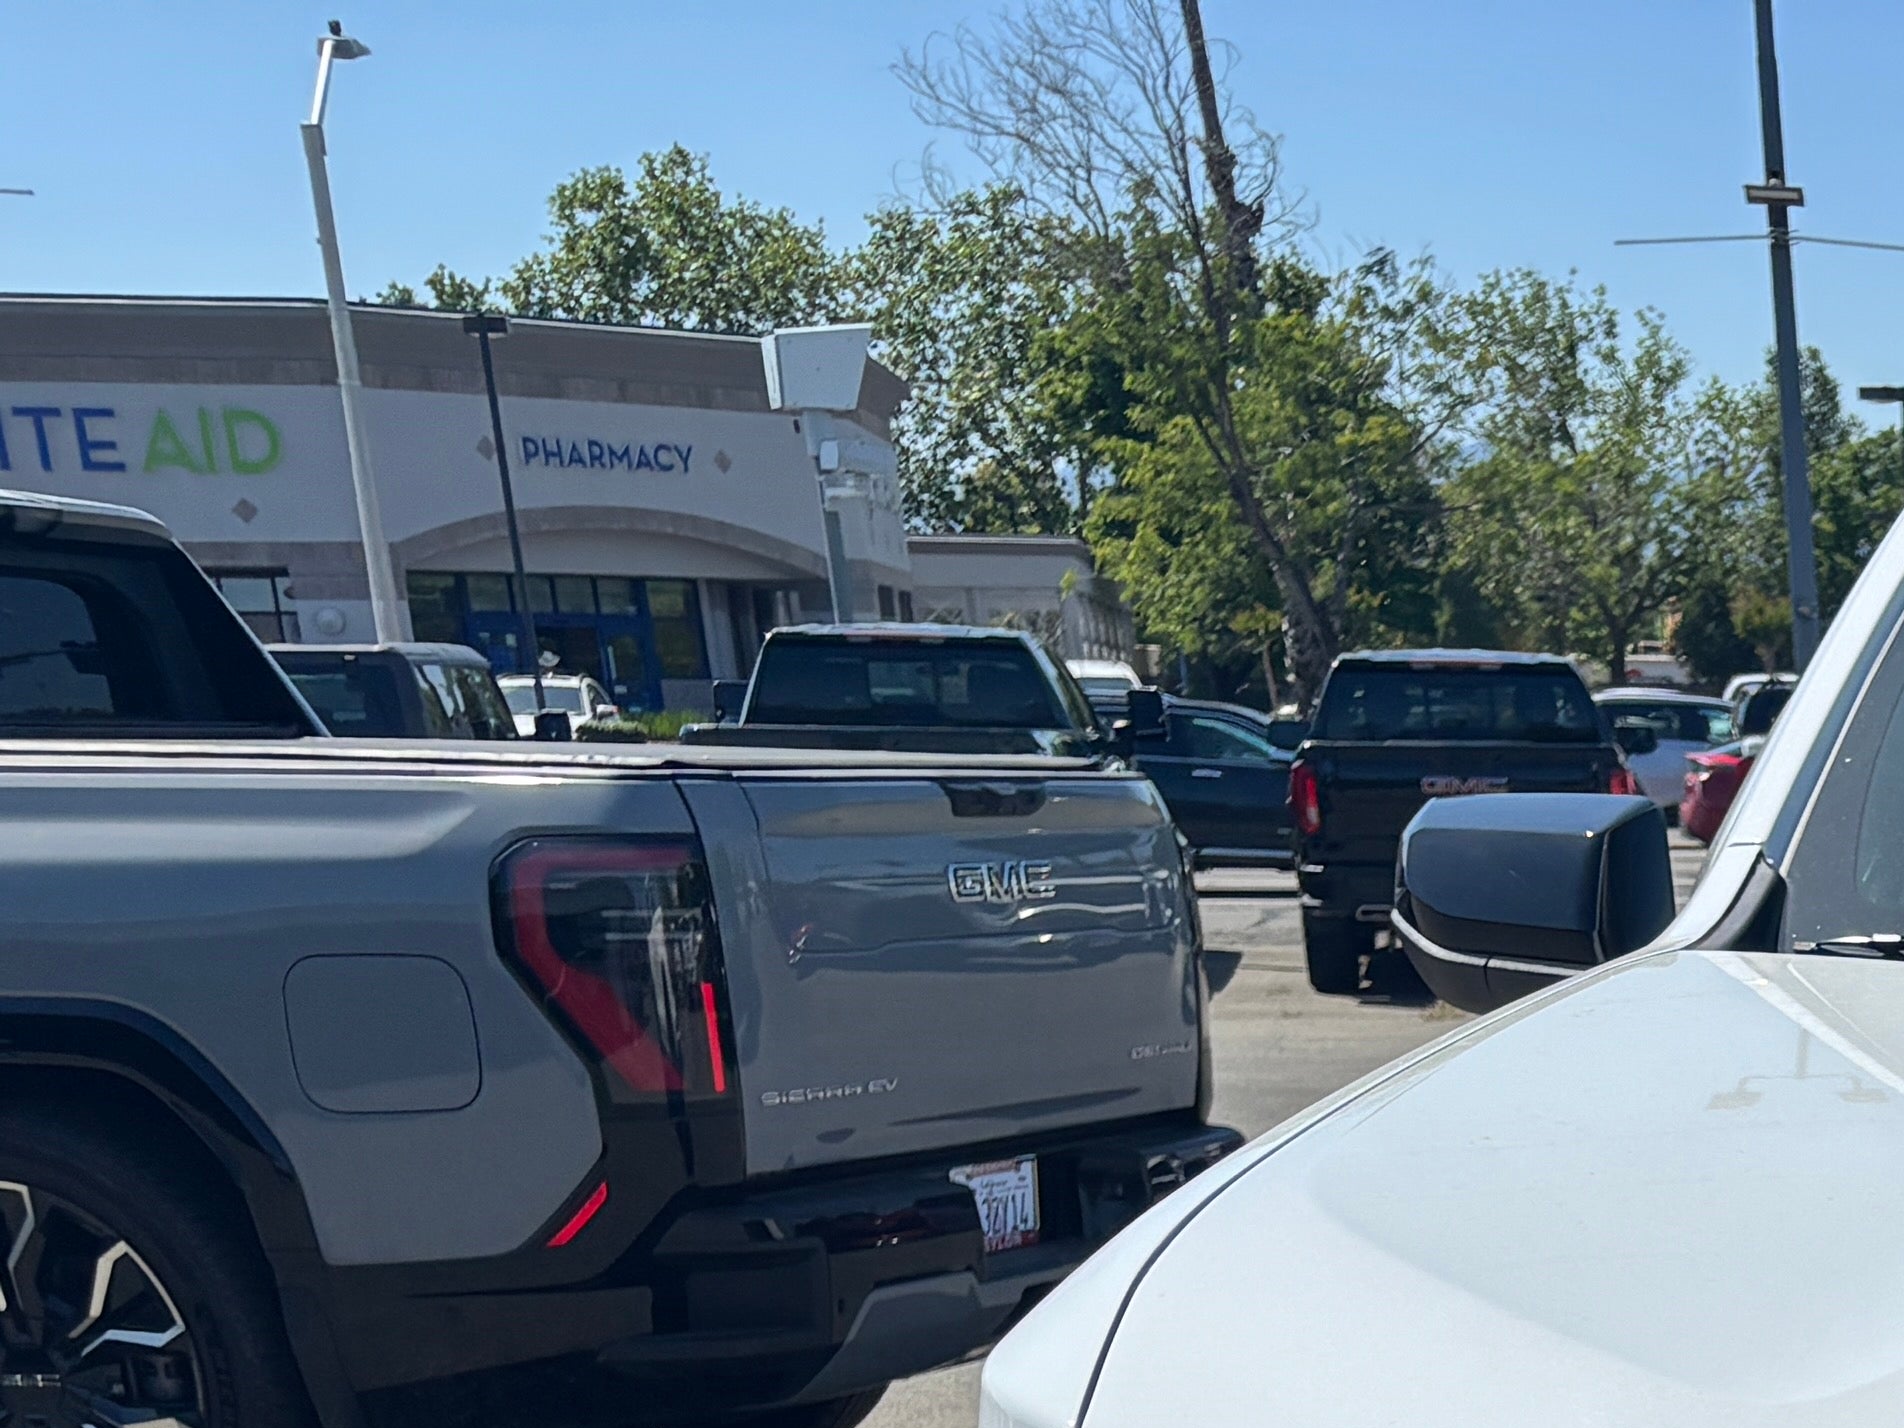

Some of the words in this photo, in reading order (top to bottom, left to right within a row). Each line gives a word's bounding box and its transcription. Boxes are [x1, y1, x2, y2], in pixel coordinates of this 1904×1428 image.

[143, 404, 282, 475] AID
[521, 436, 693, 473] PHARMACY
[948, 860, 1057, 903] GMC
